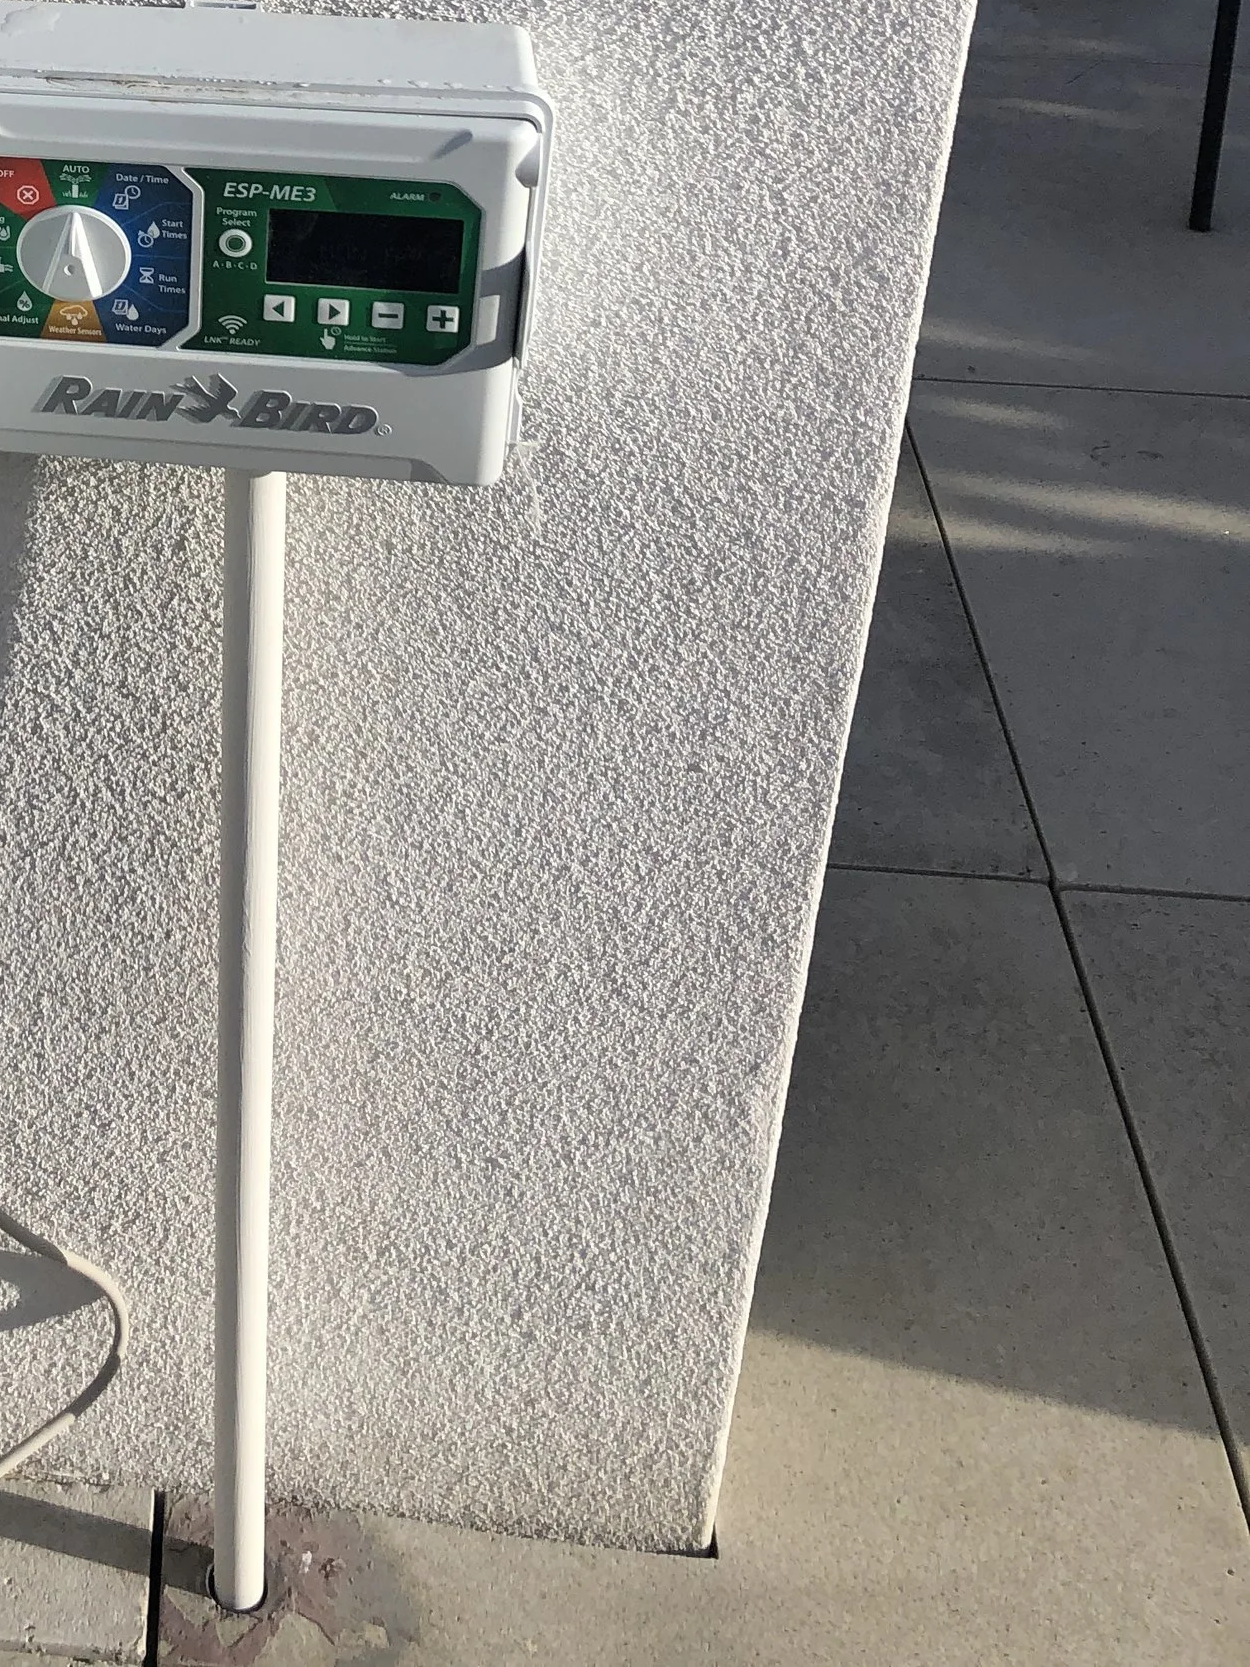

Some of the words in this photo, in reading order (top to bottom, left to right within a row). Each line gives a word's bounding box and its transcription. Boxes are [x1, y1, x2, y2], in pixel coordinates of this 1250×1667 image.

[63, 165, 90, 174] AUTO
[116, 173, 137, 183] Date
[146, 175, 169, 184] Time
[223, 182, 317, 202] ESP-ME3
[389, 192, 424, 202] ALARM
[216, 207, 258, 219] Program
[162, 219, 183, 228] Start
[222, 217, 251, 227] Select
[162, 230, 187, 239] Times
[159, 274, 177, 283] Run
[159, 285, 186, 294] Times
[12, 315, 39, 325] Adjust
[49, 325, 76, 334] Weather
[77, 327, 102, 336] Sensors
[115, 323, 142, 334] Water
[144, 325, 167, 335] Days
[229, 337, 261, 346] READY
